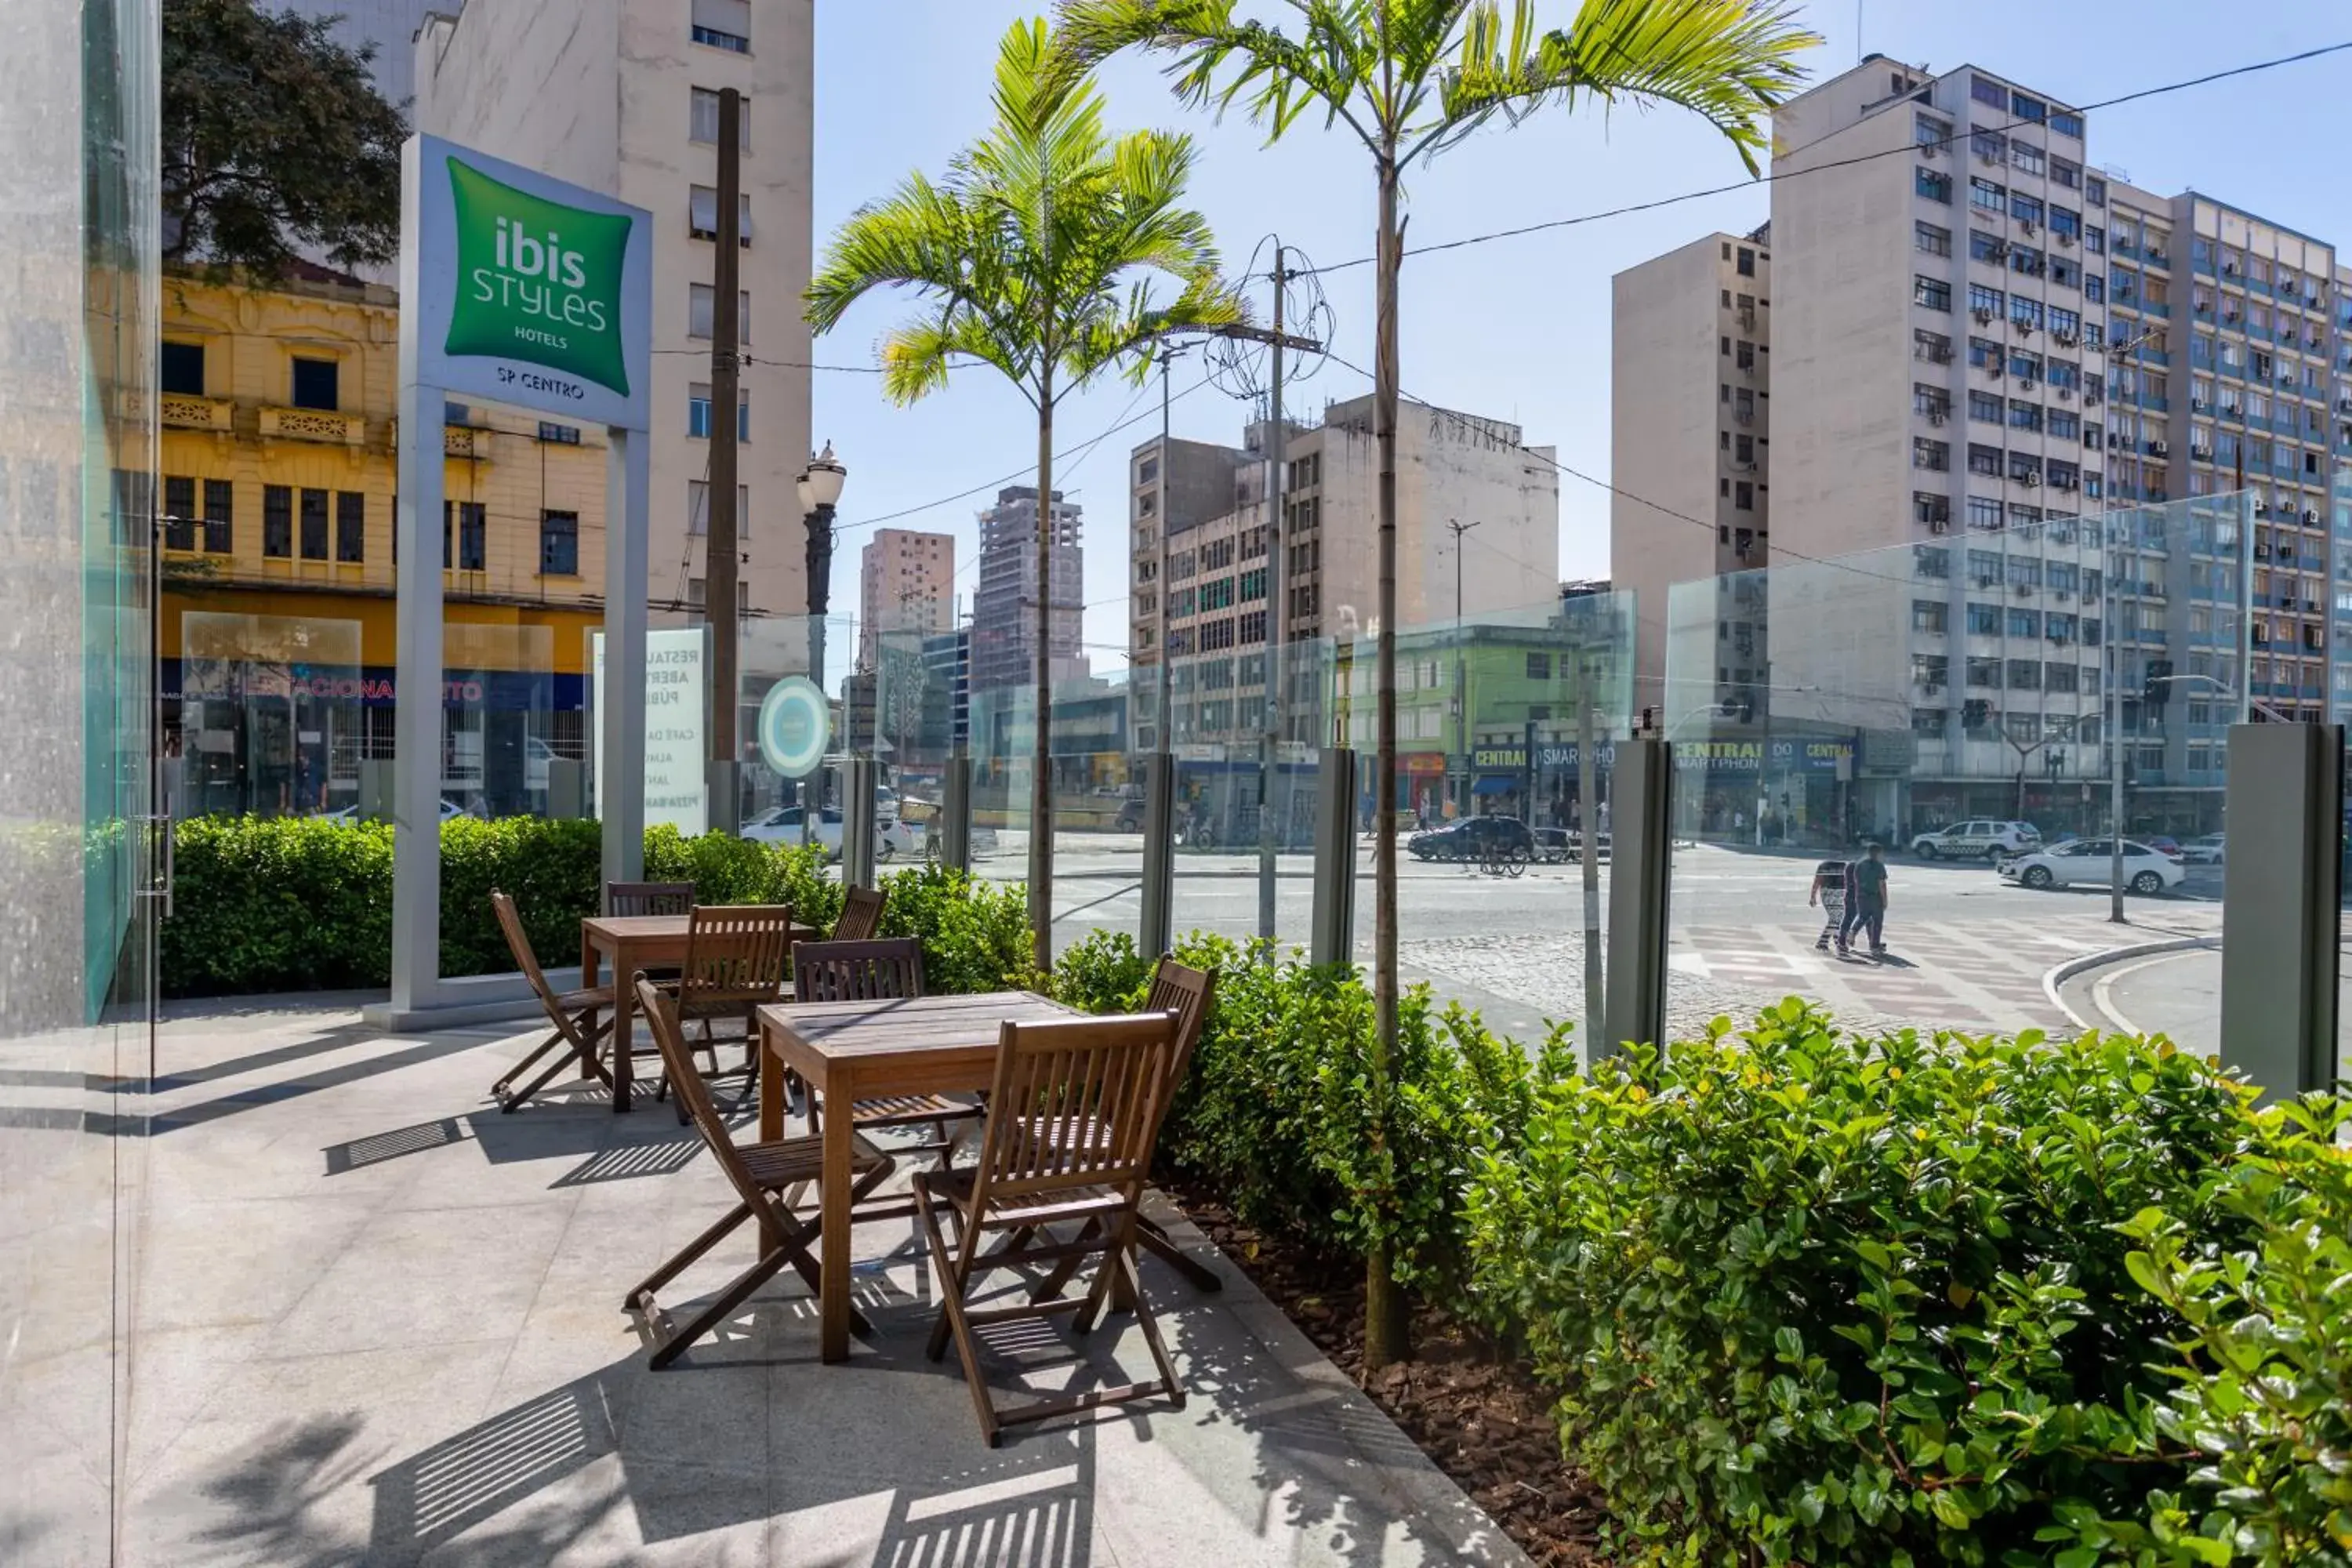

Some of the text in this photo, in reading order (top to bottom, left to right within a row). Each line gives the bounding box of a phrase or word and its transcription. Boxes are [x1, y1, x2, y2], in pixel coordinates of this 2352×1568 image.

[495, 216, 586, 289] ibis
[514, 325, 568, 350] HOTELS
[497, 367, 585, 401] SP CENTRO
[1772, 742, 1792, 757] DO
